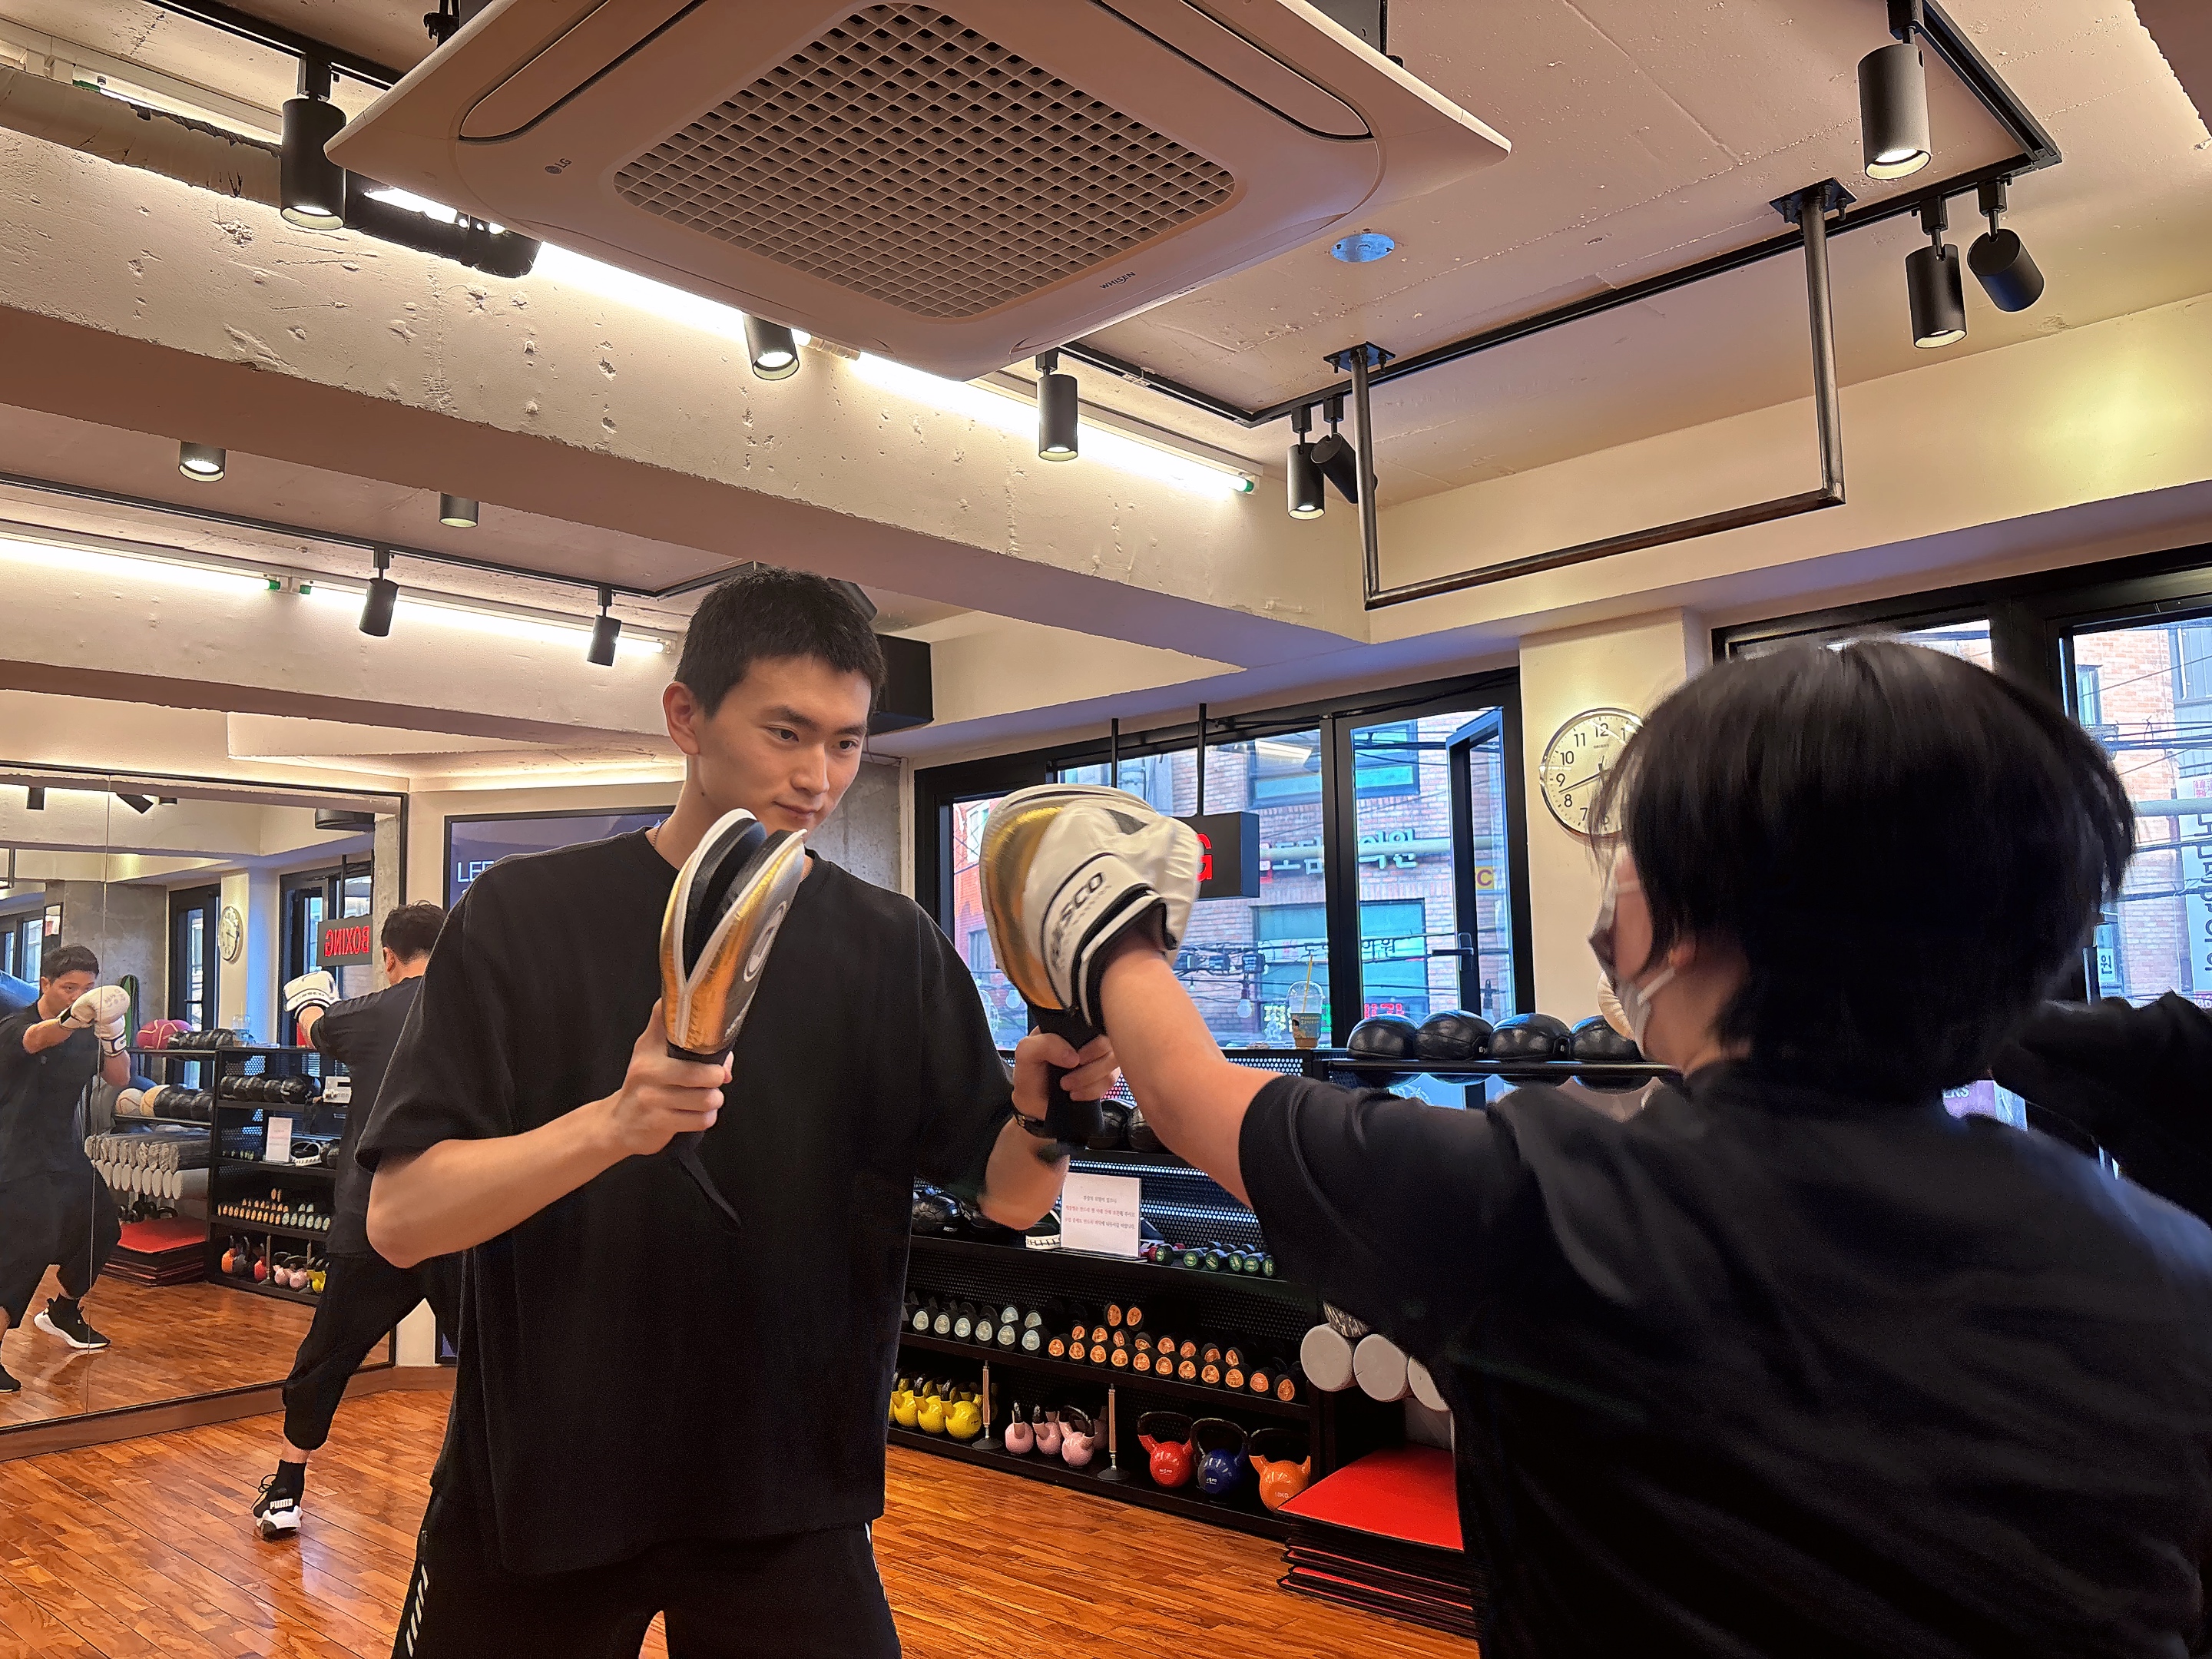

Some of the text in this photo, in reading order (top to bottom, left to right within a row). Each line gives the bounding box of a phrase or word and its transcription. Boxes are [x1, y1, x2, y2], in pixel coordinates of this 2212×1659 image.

[554, 157, 572, 168] LG
[1099, 271, 1136, 289] WHISEN
[1593, 723, 1609, 737] 12
[1574, 733, 1586, 747] 11
[1560, 750, 1575, 765] 10
[1556, 773, 1566, 787] 9
[1564, 793, 1573, 808] 8
[1579, 807, 1588, 822] 7
